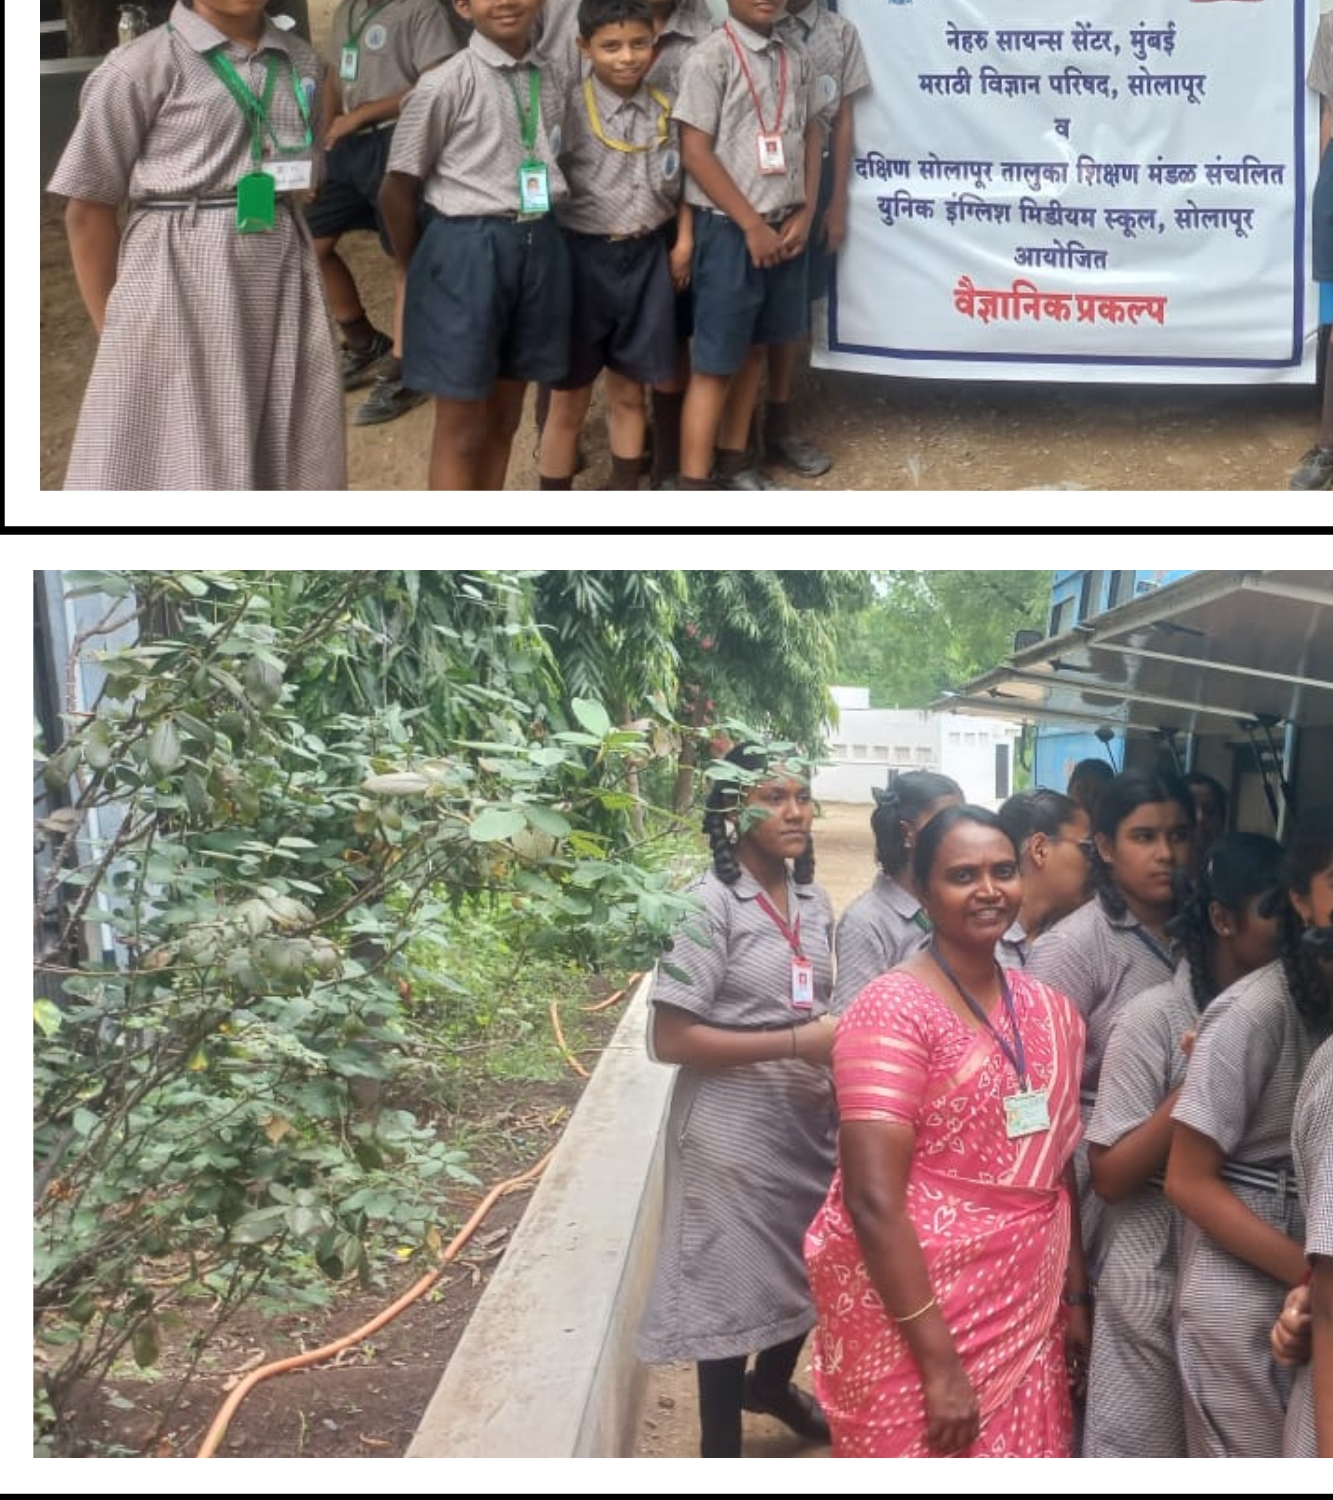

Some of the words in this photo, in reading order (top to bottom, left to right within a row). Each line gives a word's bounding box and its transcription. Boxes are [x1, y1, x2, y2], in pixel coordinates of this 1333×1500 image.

[946, 21, 989, 53] नेहरु
[996, 31, 1064, 51] सायन्स
[1071, 21, 1120, 56] सेंटर,
[1130, 21, 1176, 60] मुंबई
[918, 66, 972, 94] मराठी
[979, 66, 1041, 97] विज्ञान
[1048, 66, 1117, 99] परिषद,
[1127, 66, 1206, 104] सोलापूर
[1053, 118, 1071, 139] व
[855, 152, 911, 181] दक्षिण
[917, 152, 994, 189] सोलापूर
[999, 162, 1069, 191] तालुका
[1076, 154, 1140, 187] शिक्षण
[1147, 156, 1197, 184] मंडळ
[1204, 155, 1285, 185] संचलित
[877, 190, 935, 226] युनिक
[944, 193, 1012, 226] इंग्लिश
[1018, 196, 1096, 228] मिडीयम
[1104, 209, 1165, 238] स्कूल,
[1174, 200, 1254, 238] सोलापूर
[1014, 239, 1108, 269] आयोजित
[954, 276, 1073, 324] वैज्ञानिक
[1074, 294, 1167, 325] प्रकल्प
